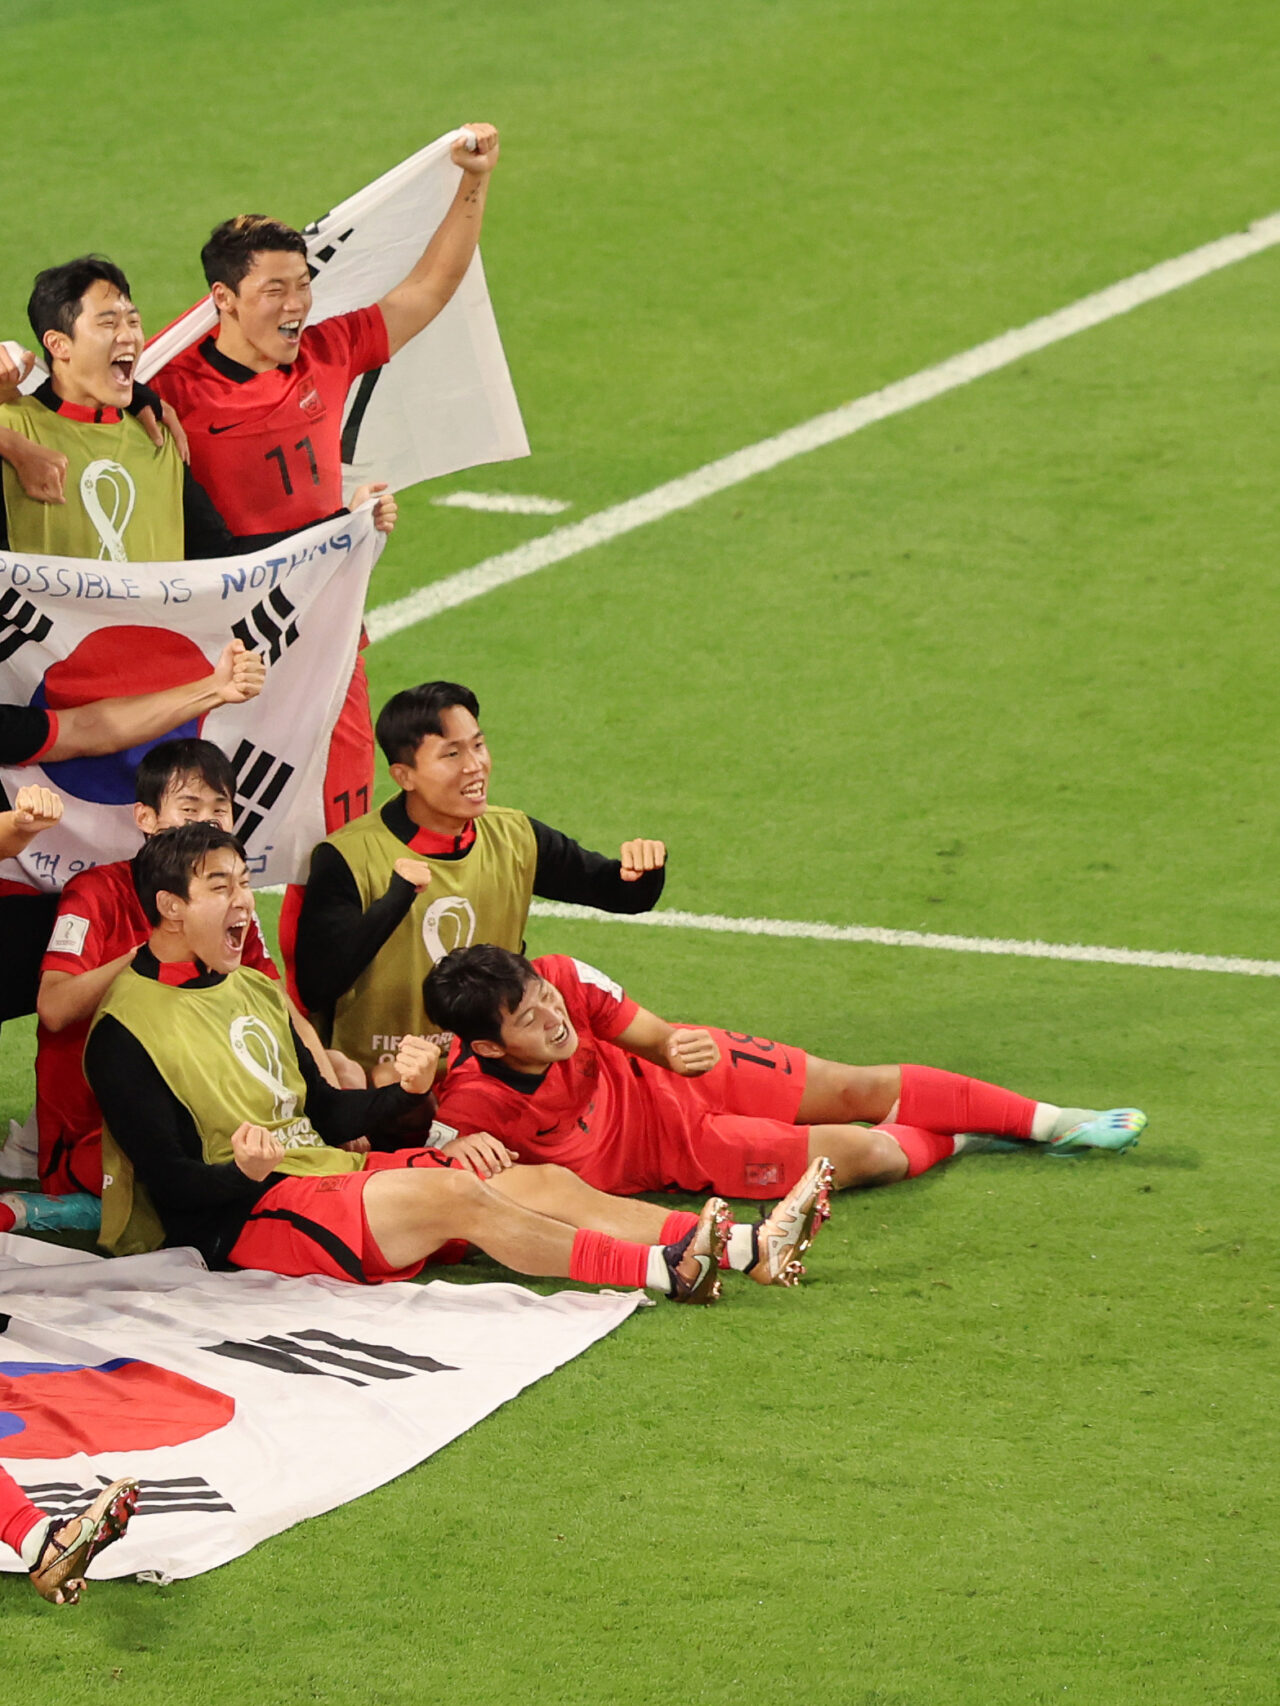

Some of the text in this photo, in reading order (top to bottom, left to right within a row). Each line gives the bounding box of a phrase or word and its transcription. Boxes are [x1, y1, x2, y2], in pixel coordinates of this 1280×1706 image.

[264, 434, 320, 496] 11
[159, 578, 192, 605] IS
[333, 784, 368, 825] 11
[372, 1034, 402, 1051] FIF
